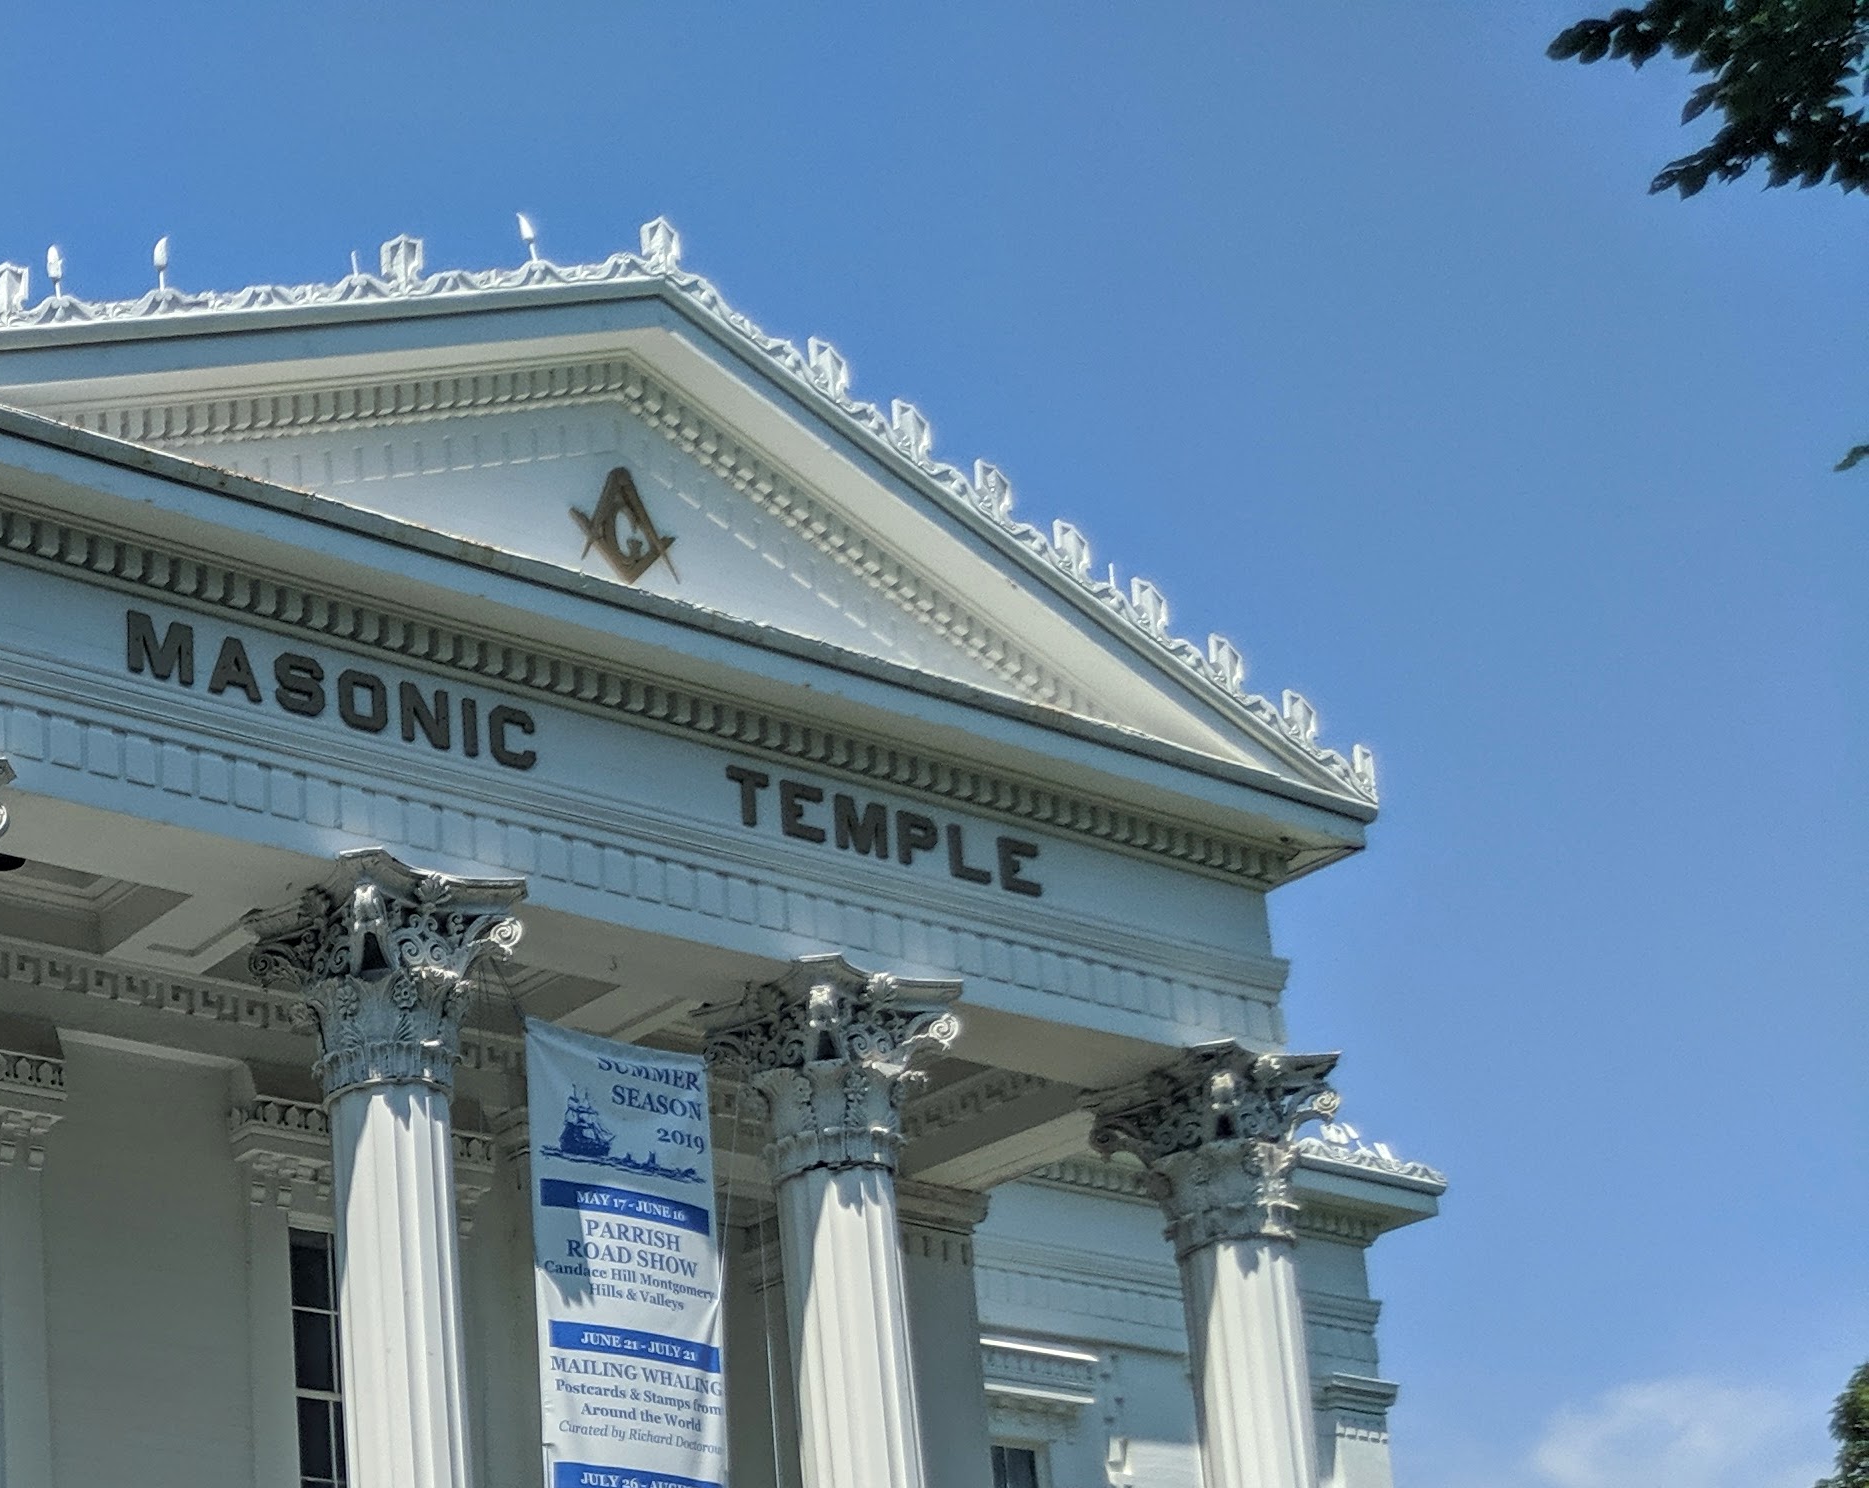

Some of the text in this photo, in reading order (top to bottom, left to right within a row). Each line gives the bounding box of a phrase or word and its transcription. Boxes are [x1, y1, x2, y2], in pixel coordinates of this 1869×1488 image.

[126, 609, 1043, 897] MASONIC TEMPLE
[598, 1057, 701, 1091] SUMMER
[611, 1085, 702, 1120] SEASON
[657, 1128, 705, 1154] 2019
[576, 1191, 610, 1206] MAY
[613, 1199, 627, 1210] 17
[636, 1200, 672, 1219] JUNE
[672, 1211, 685, 1221] 16
[585, 1219, 681, 1252] PARRISH
[566, 1239, 697, 1278] ROAD SHOW
[545, 1260, 715, 1303] Candace Hill Montgomery
[589, 1283, 684, 1311] Hills & Valleys
[581, 1332, 621, 1348] JUNE
[624, 1339, 637, 1351] 21
[648, 1341, 682, 1358] JULY
[683, 1350, 696, 1362] 21
[550, 1356, 722, 1396] MAILING WHALING
[555, 1379, 721, 1416] Postcards & Stamps from
[559, 1420, 608, 1437] Curated
[611, 1426, 625, 1441] by
[629, 1428, 672, 1447] Richard
[581, 1403, 701, 1432] Around the World
[581, 1472, 619, 1488] JULY
